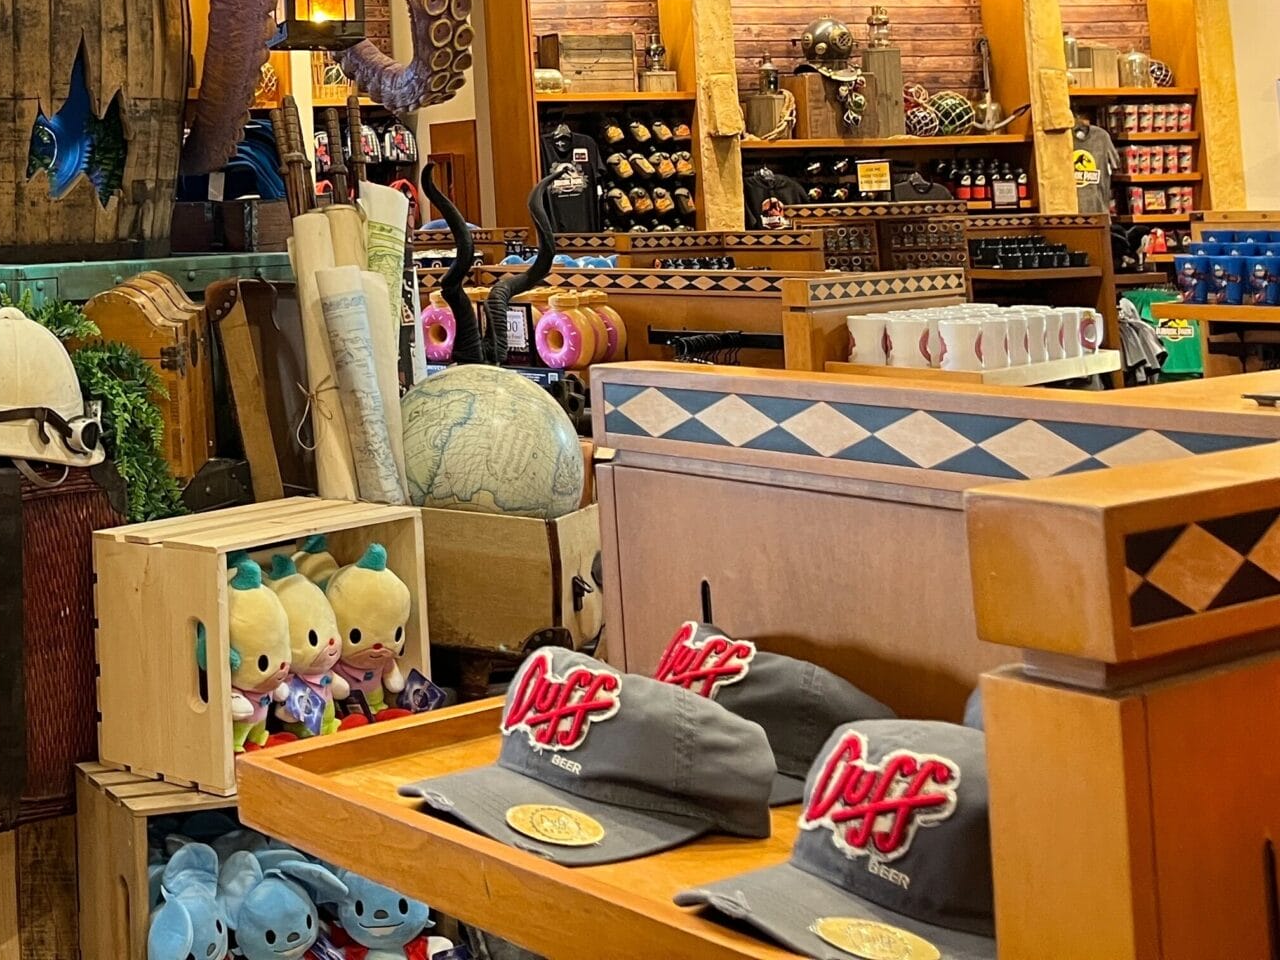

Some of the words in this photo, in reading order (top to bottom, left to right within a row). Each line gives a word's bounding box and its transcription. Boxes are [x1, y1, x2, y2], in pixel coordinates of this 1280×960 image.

[652, 623, 752, 697] Duff
[505, 654, 618, 747] Duff
[551, 753, 583, 775] BEER
[805, 732, 950, 853] Duff
[867, 857, 911, 890] BEER
